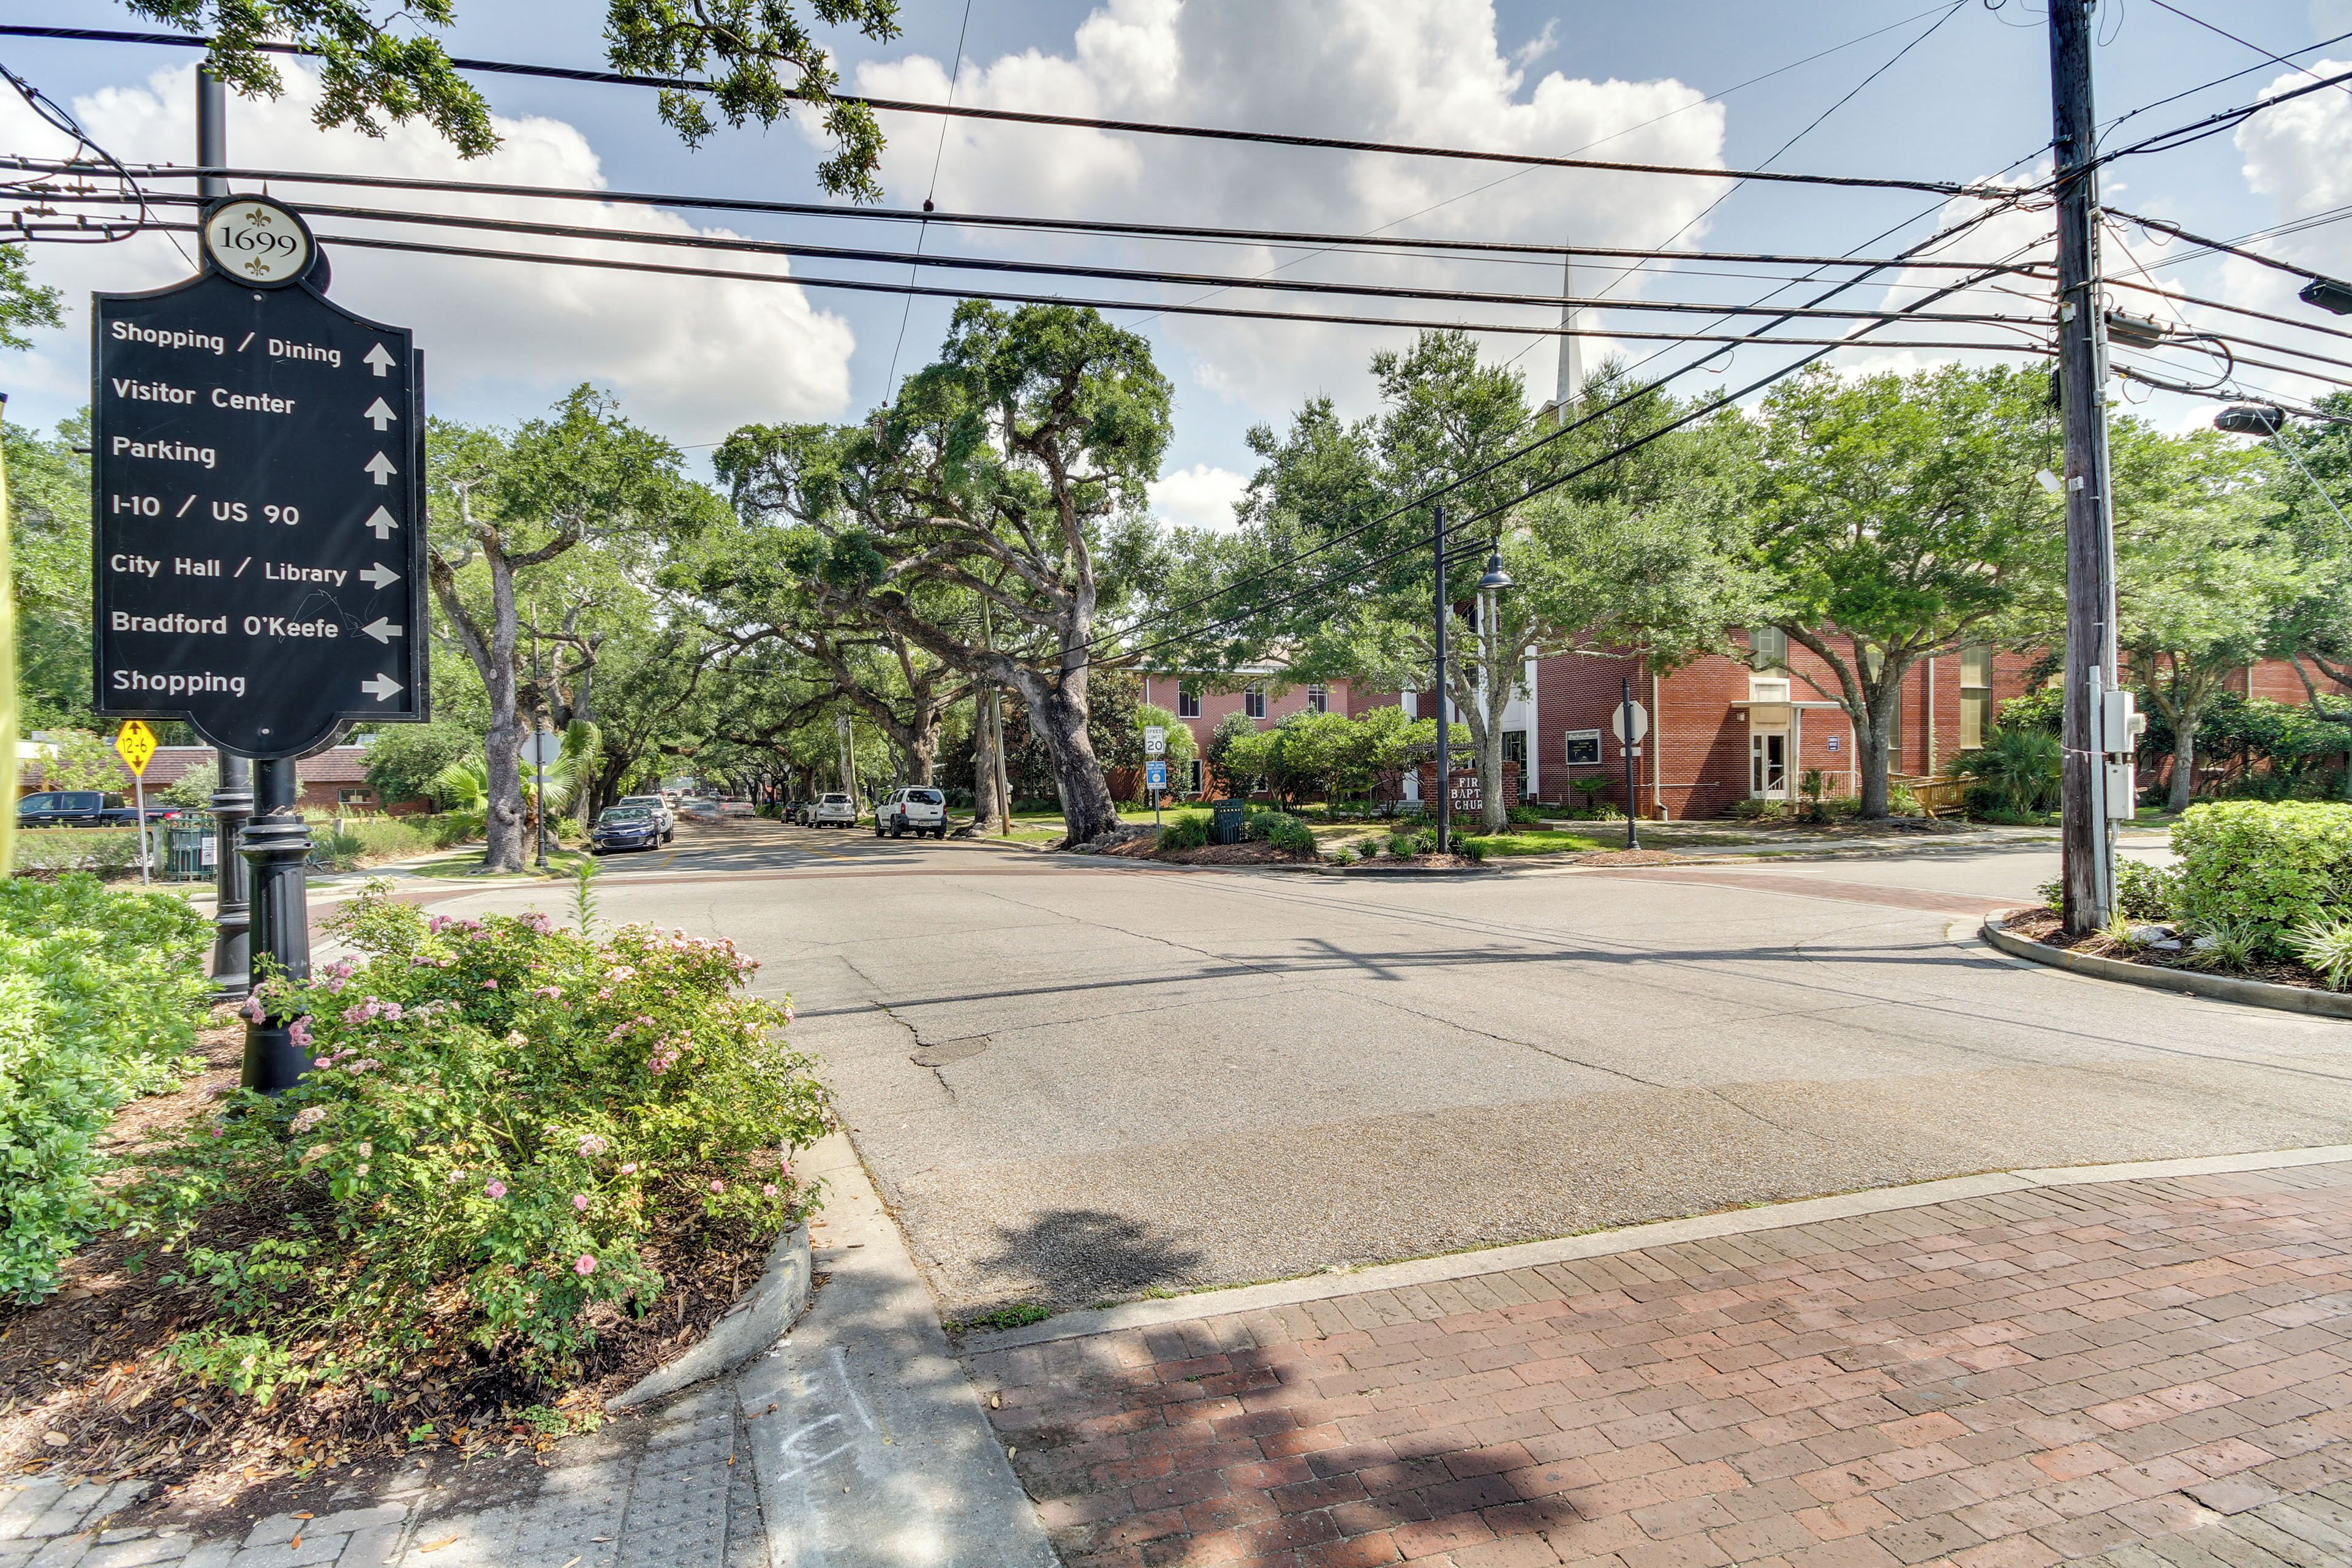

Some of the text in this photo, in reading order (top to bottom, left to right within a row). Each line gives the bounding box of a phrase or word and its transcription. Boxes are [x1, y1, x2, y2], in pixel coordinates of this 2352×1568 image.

[220, 226, 297, 258] 1699
[111, 320, 341, 368] Shopping / Dining
[112, 377, 295, 415] Visitor Center
[113, 435, 216, 469] Parking
[113, 494, 300, 526] I-10 / US 90
[111, 554, 347, 587] City Hall / Library
[112, 611, 339, 638] Bradford O'Keefe
[113, 669, 246, 698] Shopping
[1147, 741, 1163, 750] 20
[1451, 788, 1481, 799] BAPT
[1459, 777, 1478, 787] FIR
[1455, 800, 1482, 810] CHUR
